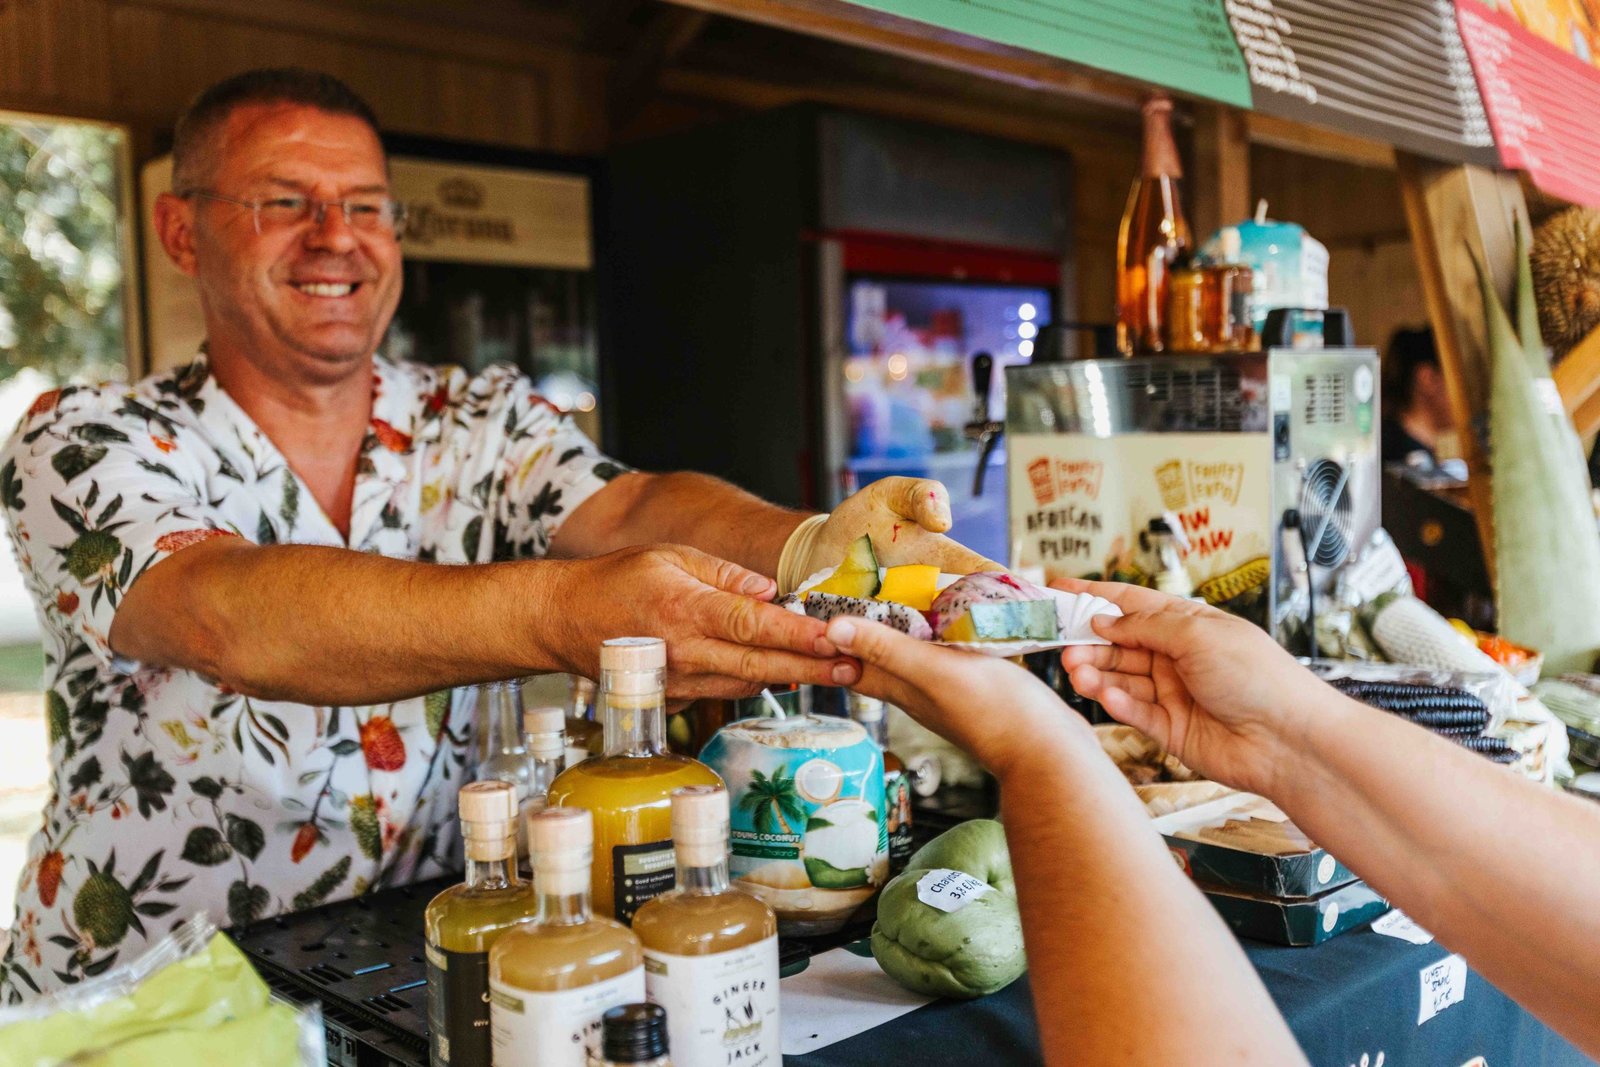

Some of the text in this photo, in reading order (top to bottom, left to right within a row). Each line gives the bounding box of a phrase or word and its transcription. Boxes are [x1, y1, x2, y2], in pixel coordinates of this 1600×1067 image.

[1026, 505, 1102, 532] AFRICAN
[1039, 535, 1091, 560] PLUM
[731, 831, 801, 844] YOUNG COCONUT
[713, 980, 765, 1005] GINGER
[727, 1043, 760, 1065] JACK
